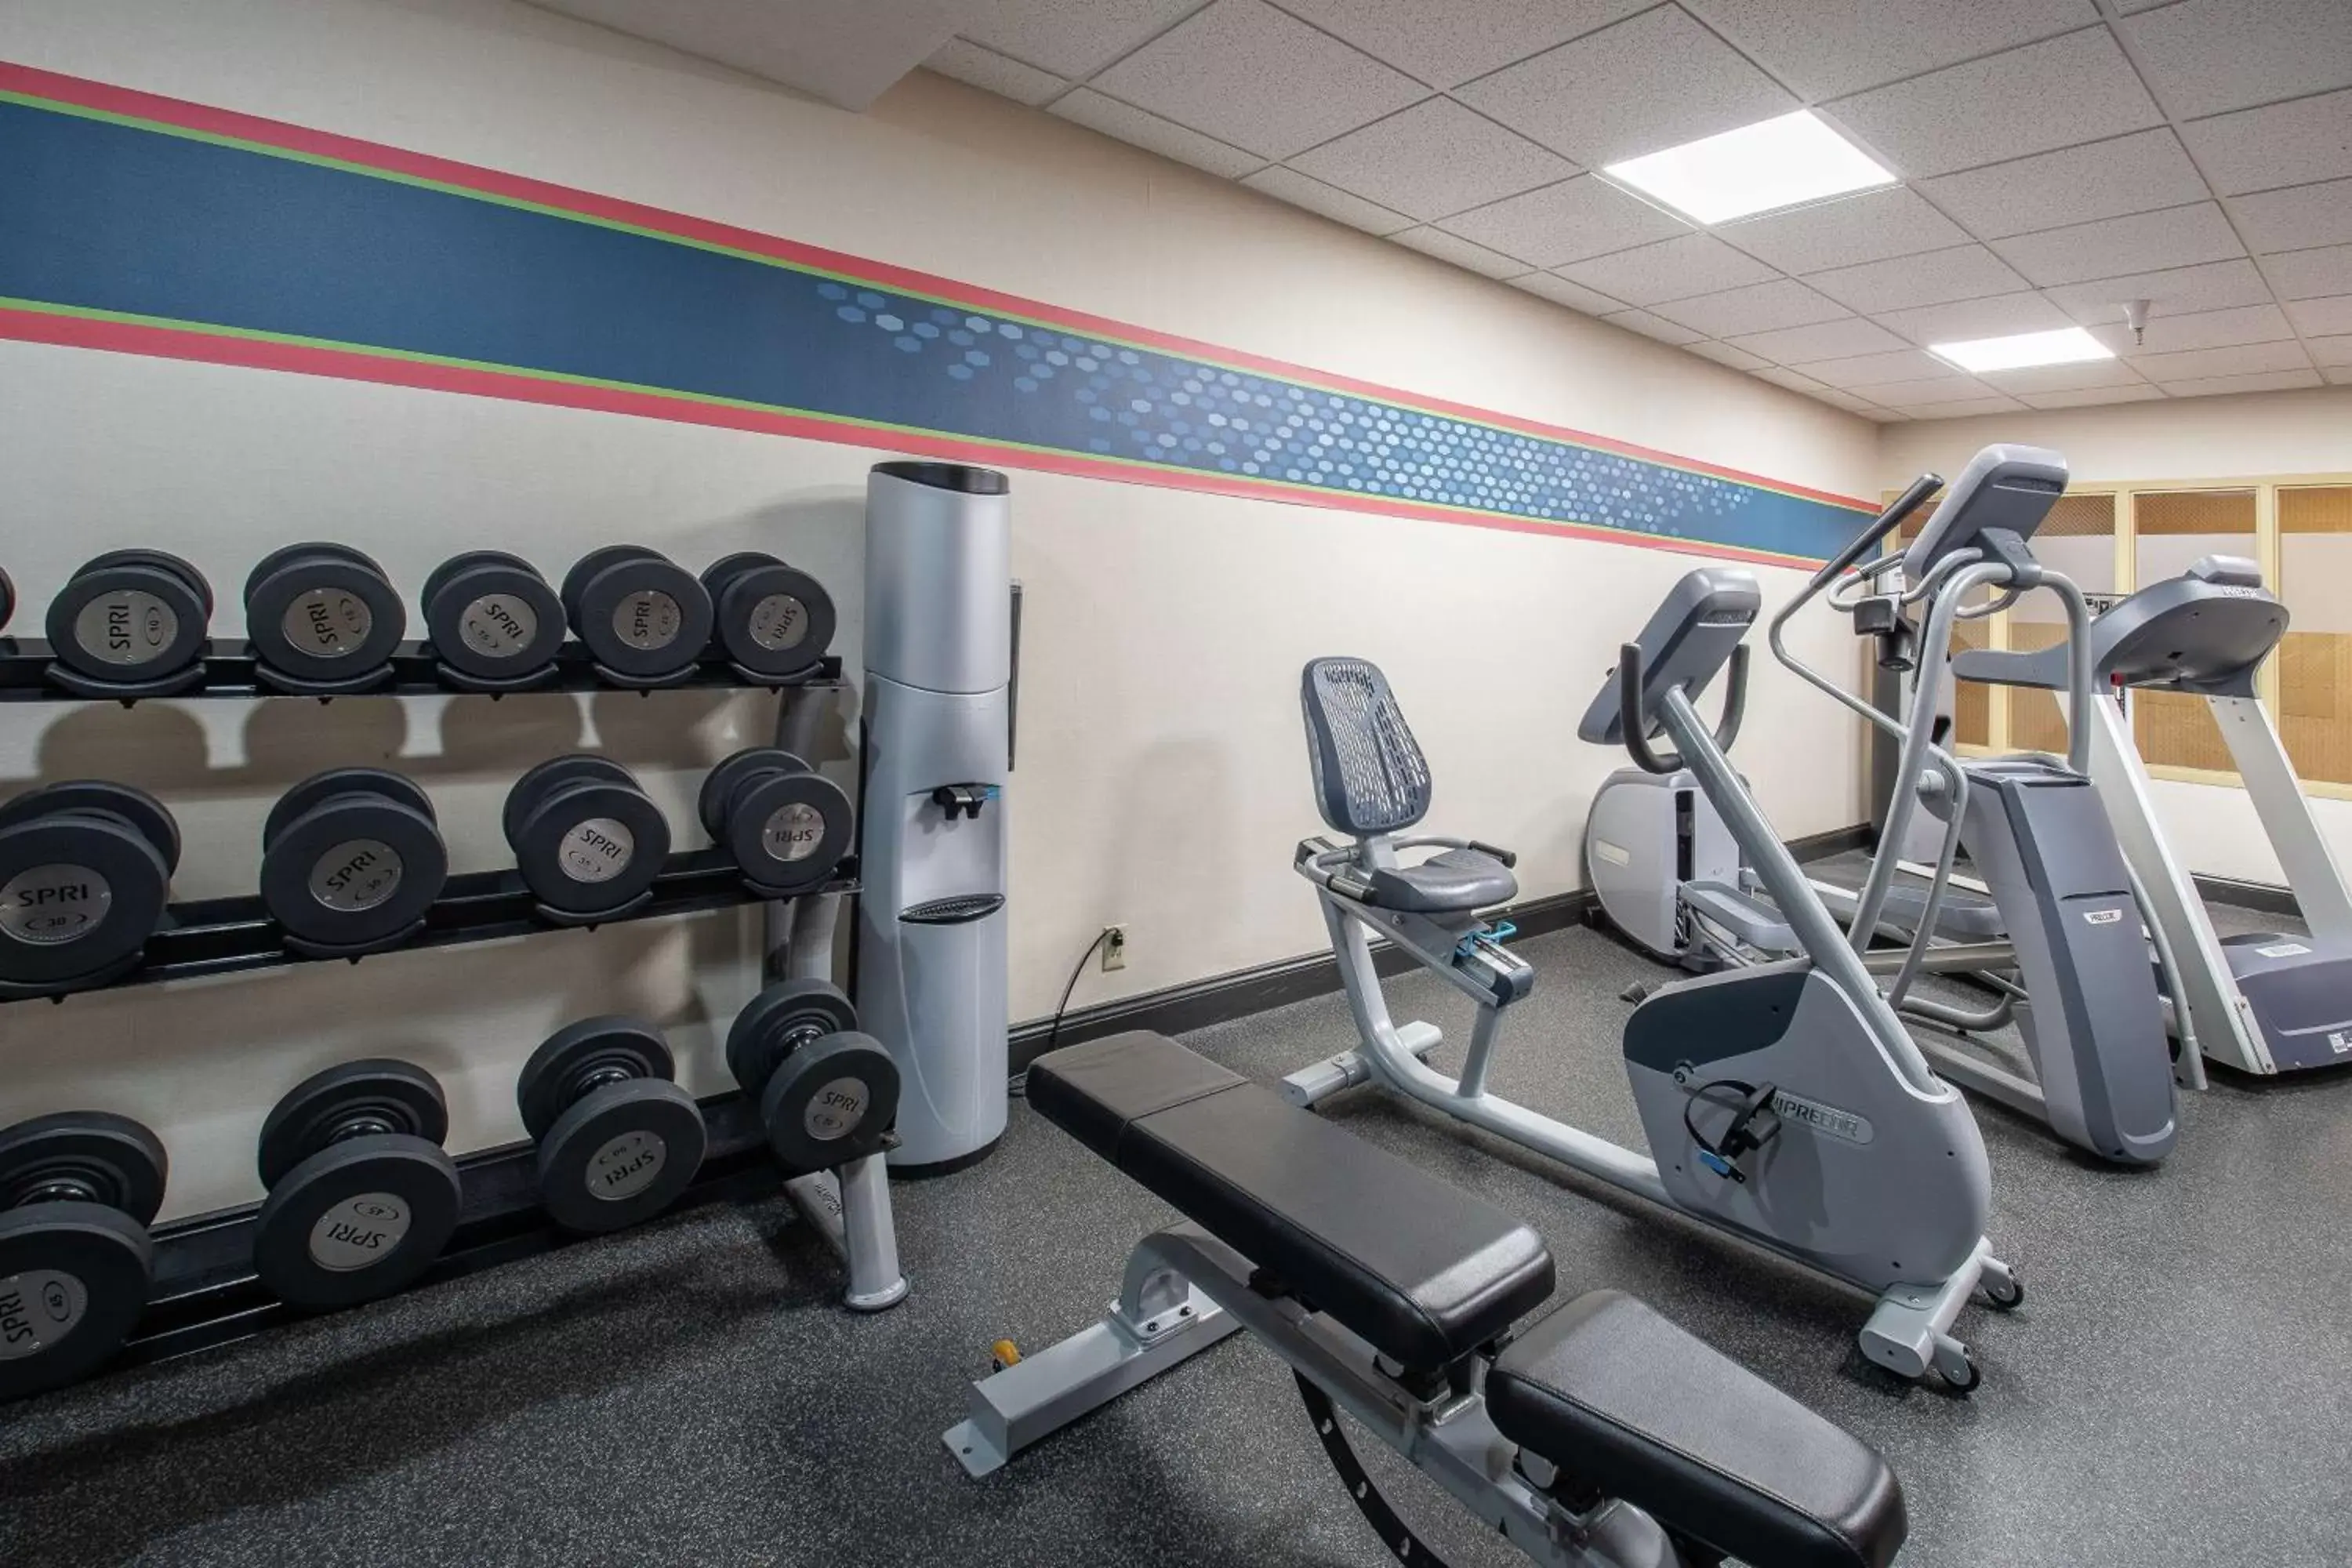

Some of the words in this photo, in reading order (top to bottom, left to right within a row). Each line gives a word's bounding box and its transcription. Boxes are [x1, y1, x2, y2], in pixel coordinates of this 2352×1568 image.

[109, 604, 129, 650] SPRI
[307, 603, 338, 643] SPRI
[486, 604, 524, 638] SPRI
[634, 601, 651, 637] SPRI
[772, 607, 797, 639] SPRI
[580, 829, 622, 858] SPRI
[775, 828, 814, 843] SPRI
[326, 851, 377, 891] SPRI
[18, 884, 89, 907] SPRI
[822, 1091, 858, 1112] SPRI
[1784, 1101, 1858, 1138] PRECOR
[606, 1150, 656, 1186] SPRI
[326, 1222, 387, 1249] SPRI
[0, 1290, 34, 1344] SPRI
